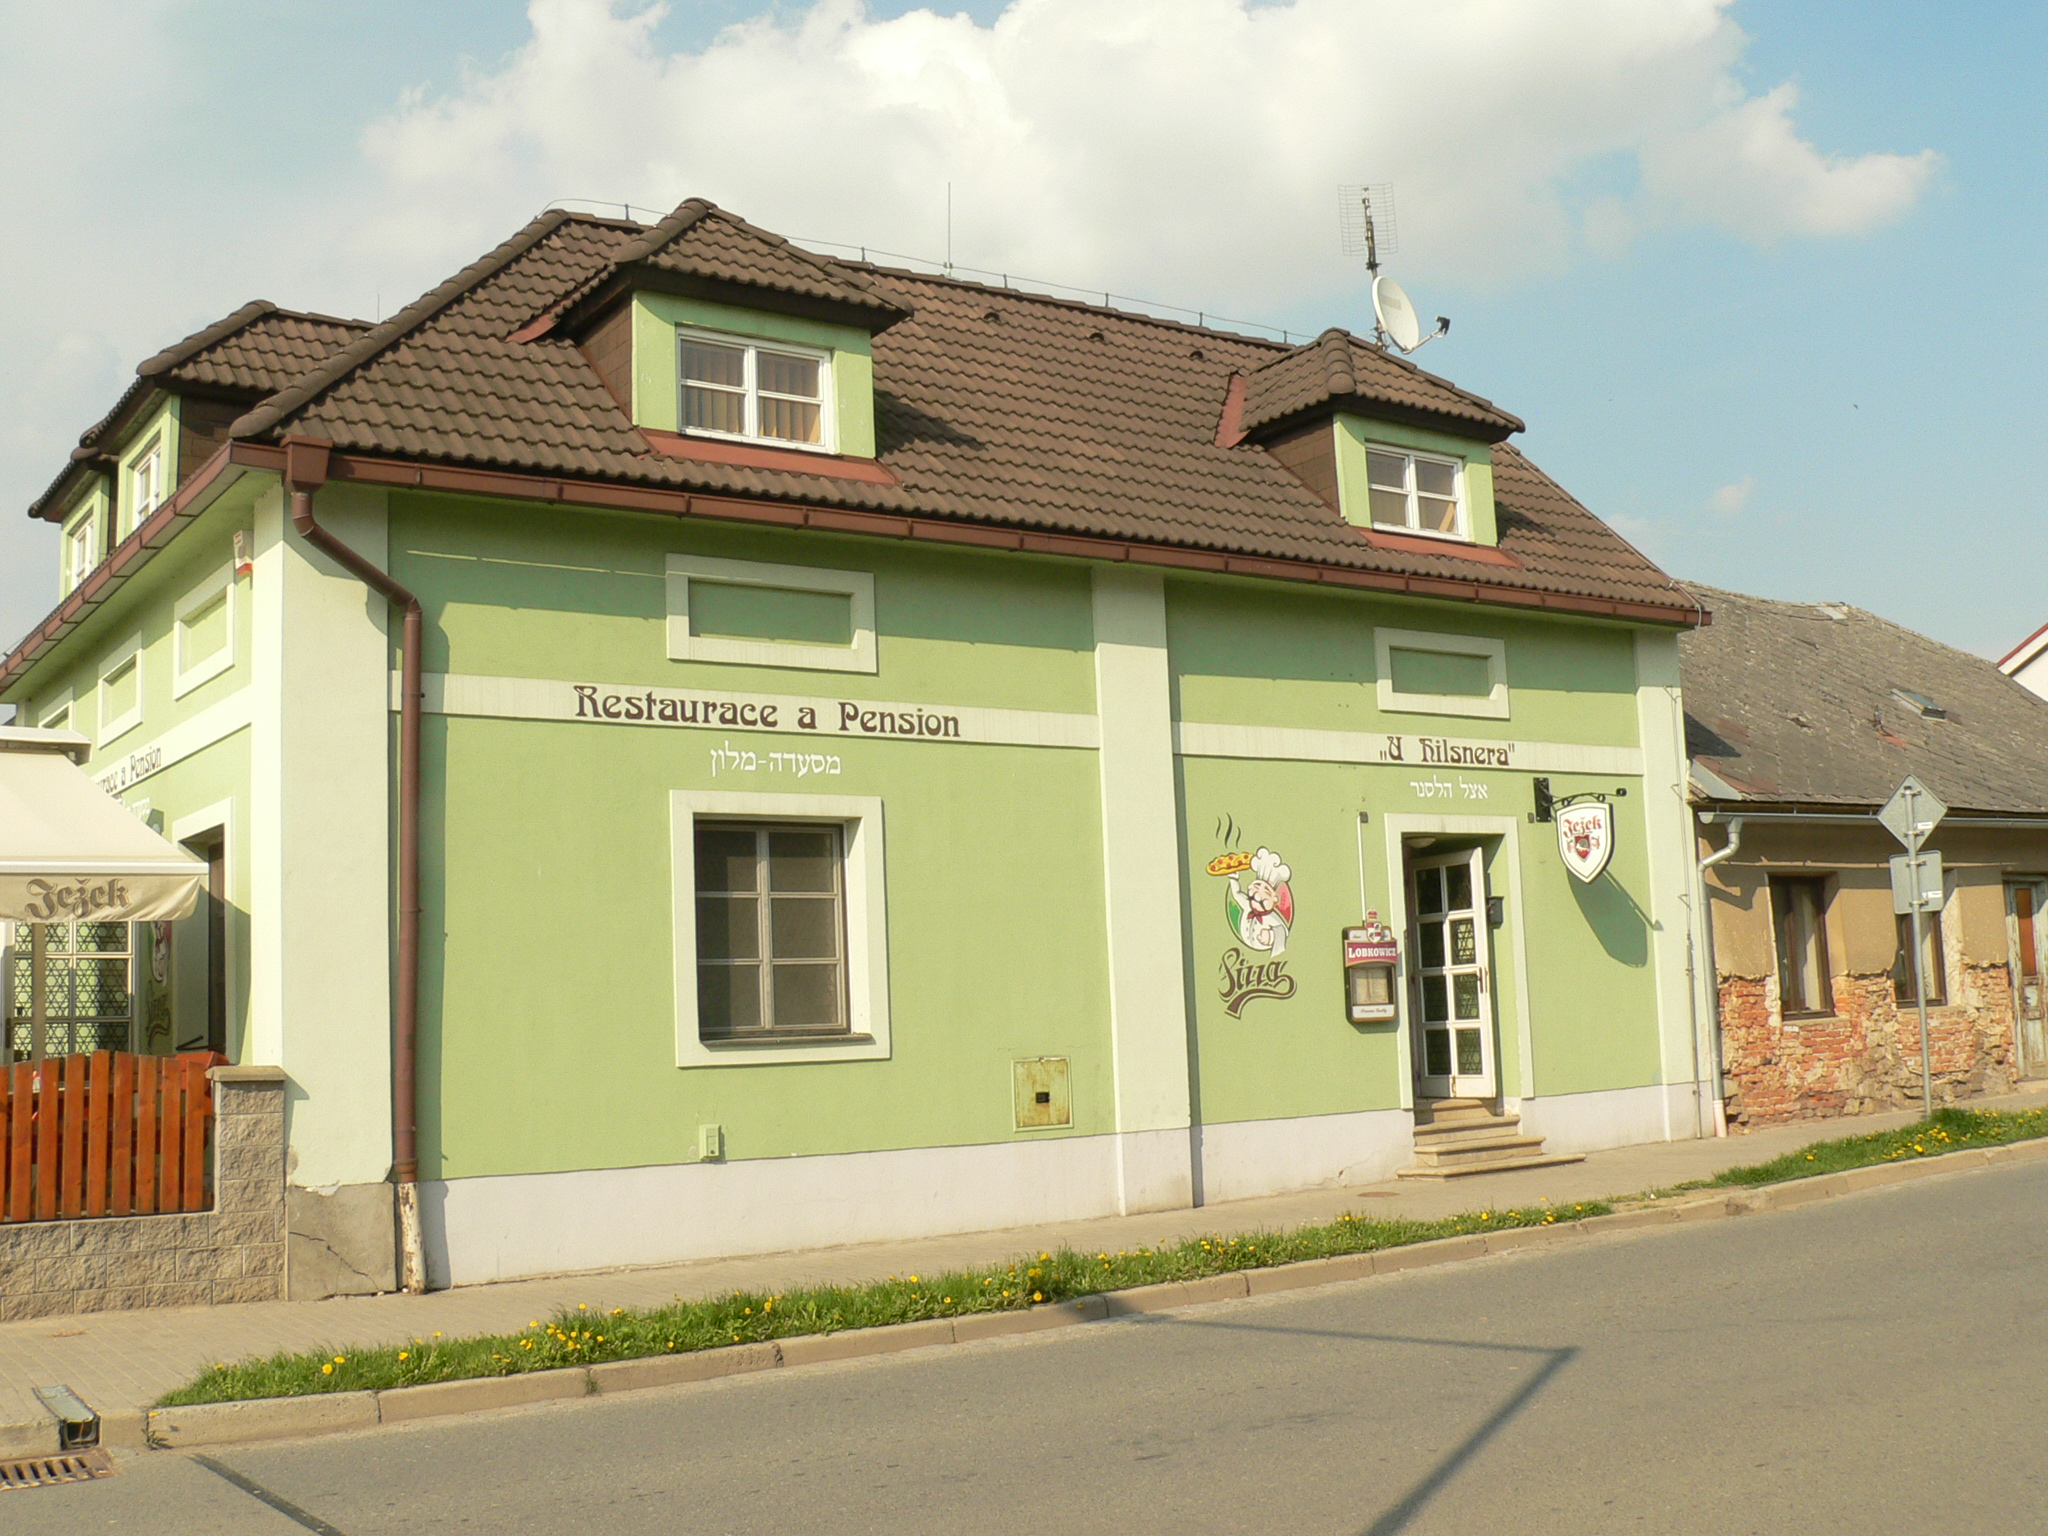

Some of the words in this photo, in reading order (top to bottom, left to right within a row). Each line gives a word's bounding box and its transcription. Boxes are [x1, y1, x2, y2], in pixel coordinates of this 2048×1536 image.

[573, 685, 779, 728] Restaurace
[797, 706, 818, 730] a
[838, 701, 961, 737] Pension
[130, 746, 161, 782] Pension
[710, 740, 841, 778] מסעדה-מלון
[1410, 774, 1453, 798] הלסנר
[1459, 775, 1488, 799] אצל
[25, 878, 132, 918] Ježek
[1348, 947, 1397, 959] LOBKOWICZ
[1218, 947, 1297, 1019] Pizza
